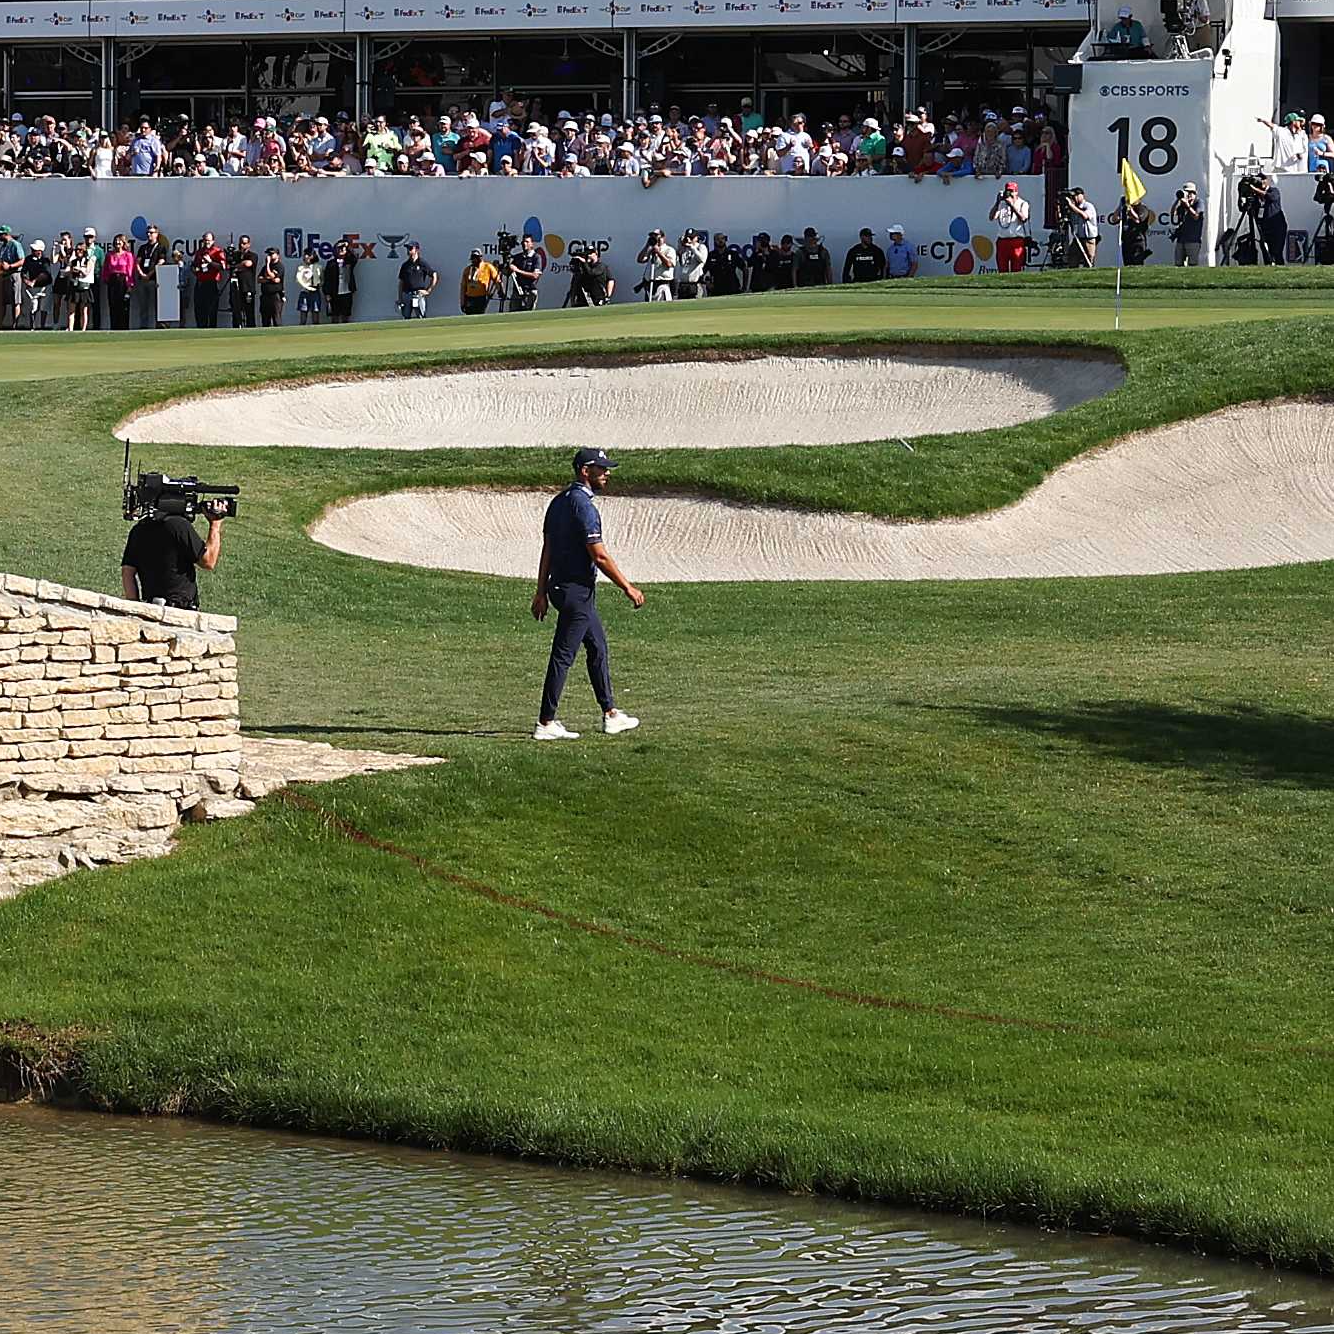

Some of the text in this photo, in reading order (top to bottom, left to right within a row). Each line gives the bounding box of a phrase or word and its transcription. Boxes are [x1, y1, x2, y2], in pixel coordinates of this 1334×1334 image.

[1111, 85, 1190, 97] CBS SPORTS
[1107, 116, 1179, 175] 18
[307, 233, 377, 260] FeEx
[930, 241, 955, 264] CJ
